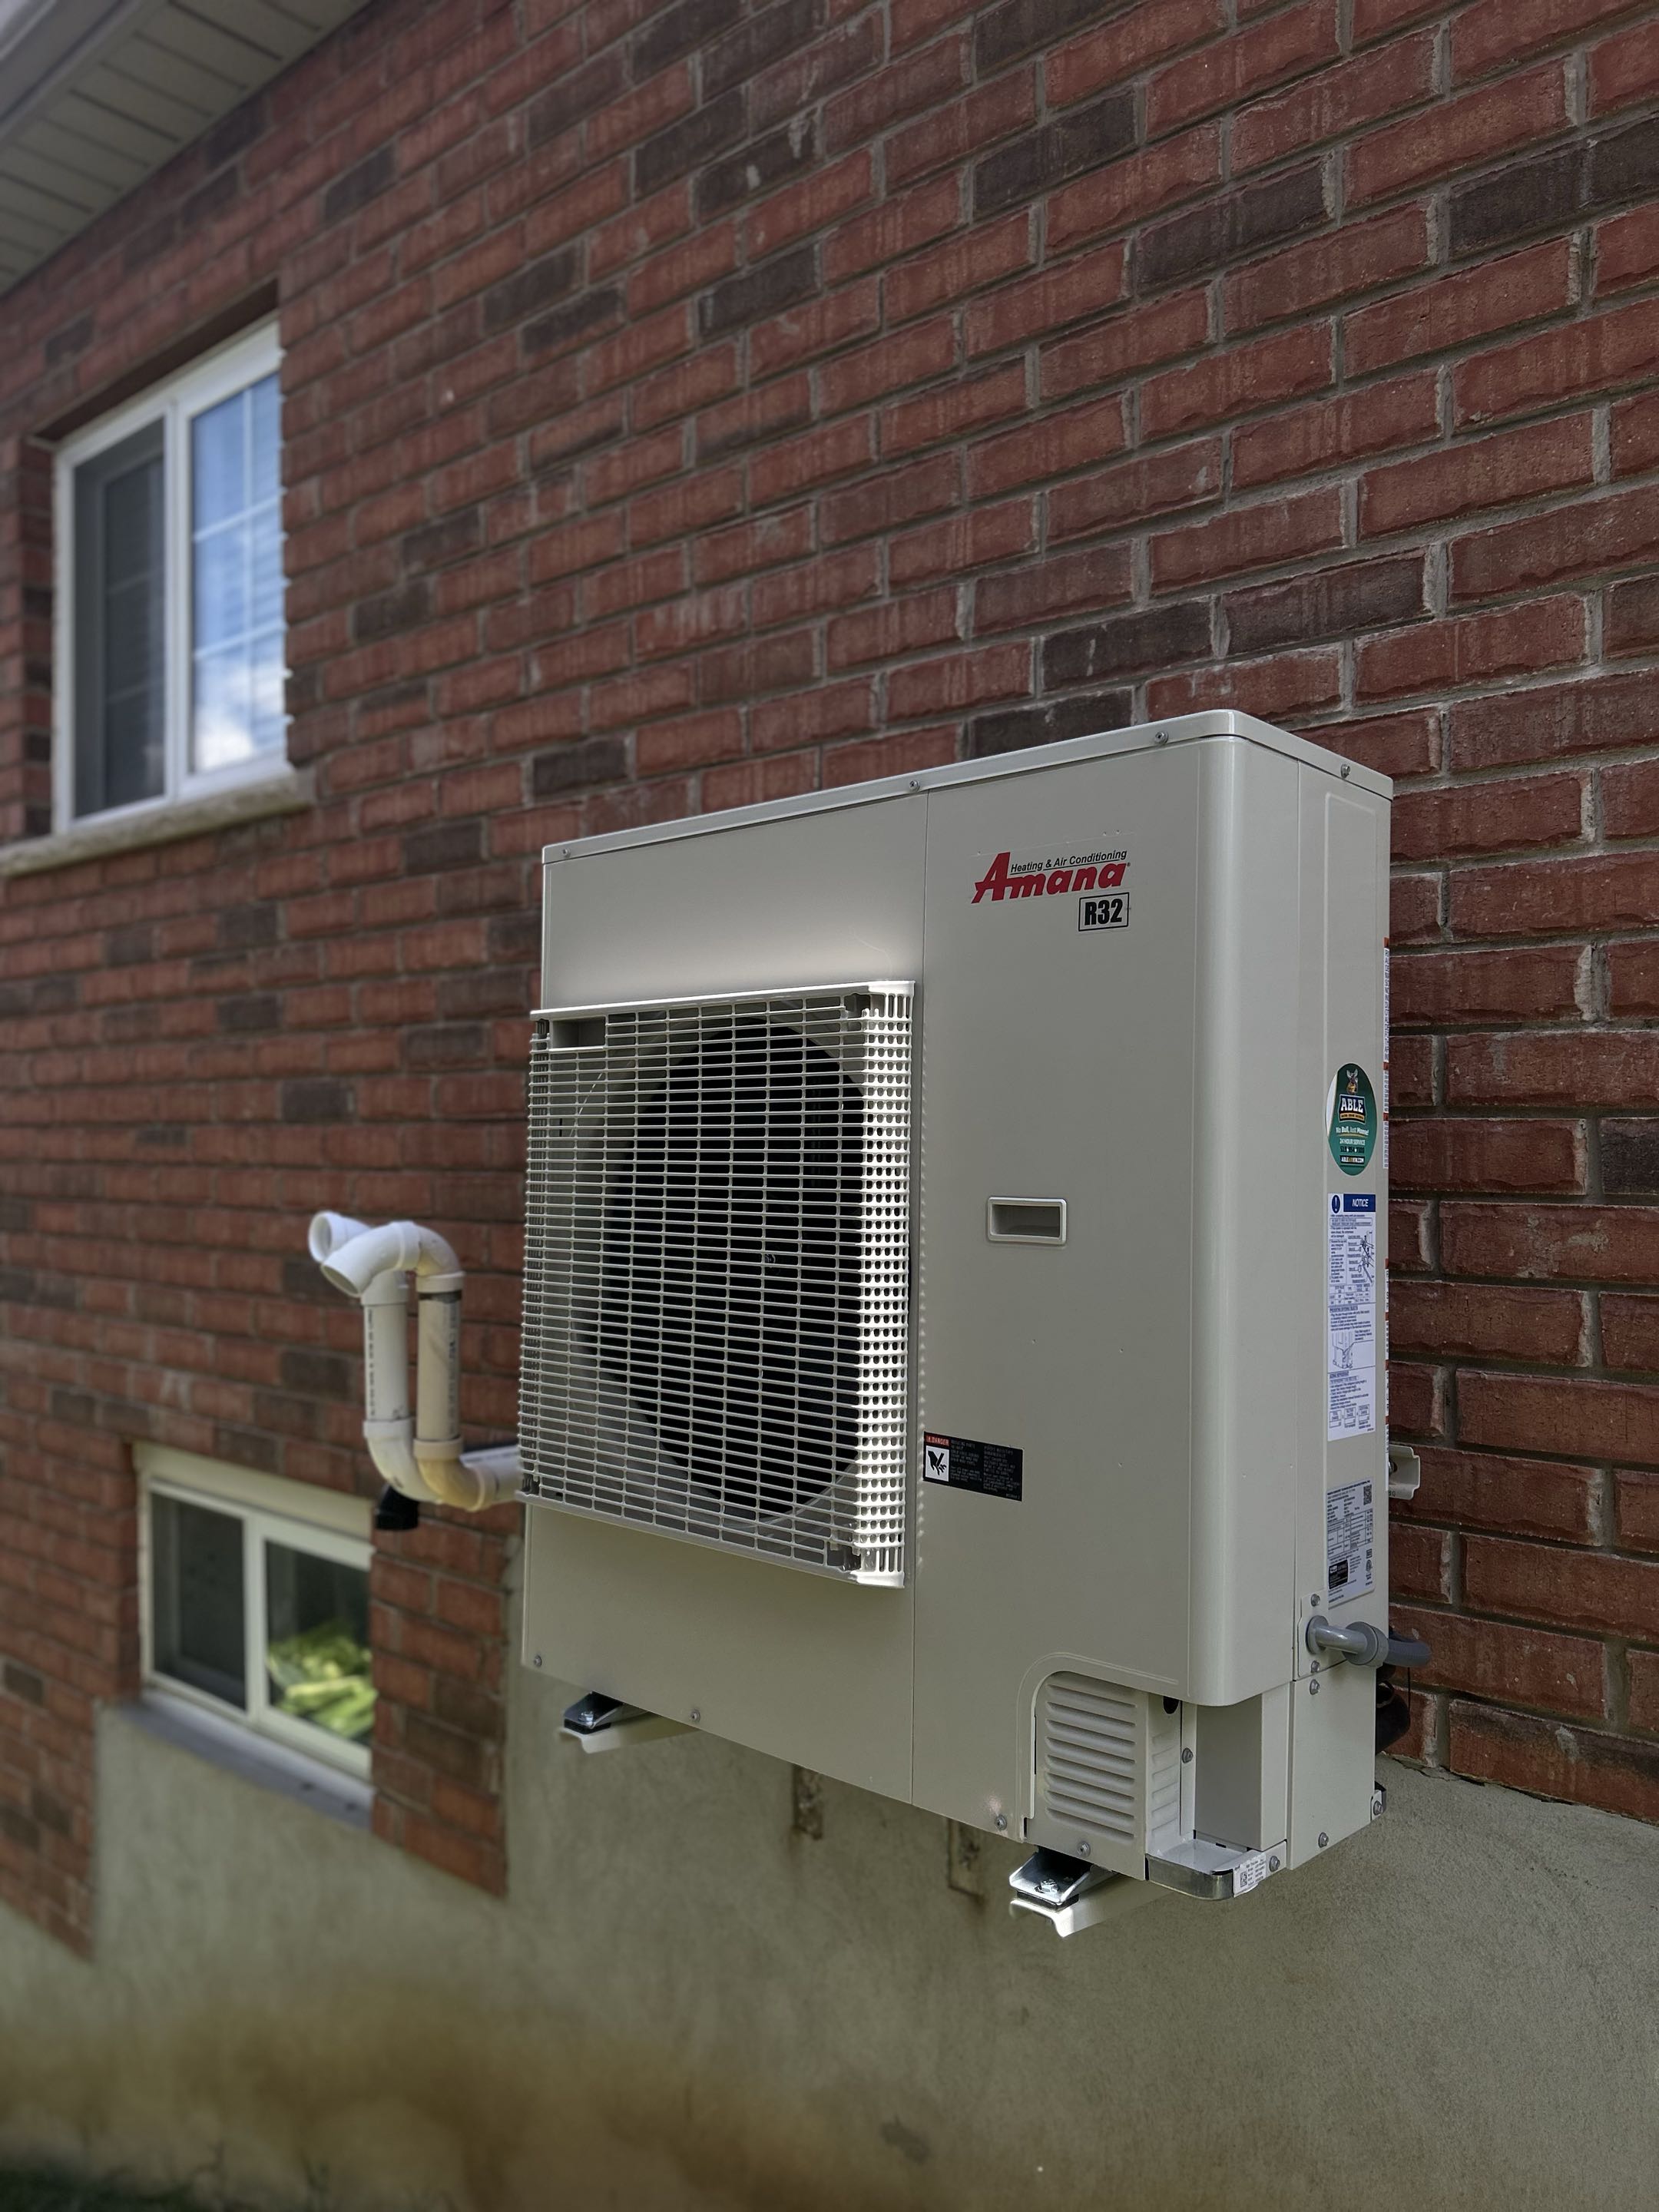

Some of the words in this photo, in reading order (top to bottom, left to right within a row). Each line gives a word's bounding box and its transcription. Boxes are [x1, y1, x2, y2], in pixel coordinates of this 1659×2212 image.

[1011, 861, 1044, 873] Heating
[1045, 859, 1052, 868] &
[1053, 857, 1068, 867] Air
[1069, 849, 1127, 866] Conditioning
[971, 852, 1127, 904] Amana
[1084, 898, 1123, 926] R32
[1341, 1098, 1364, 1114] ABLE
[1352, 1198, 1369, 1207] NOTICE
[932, 1436, 949, 1446] DANGER
